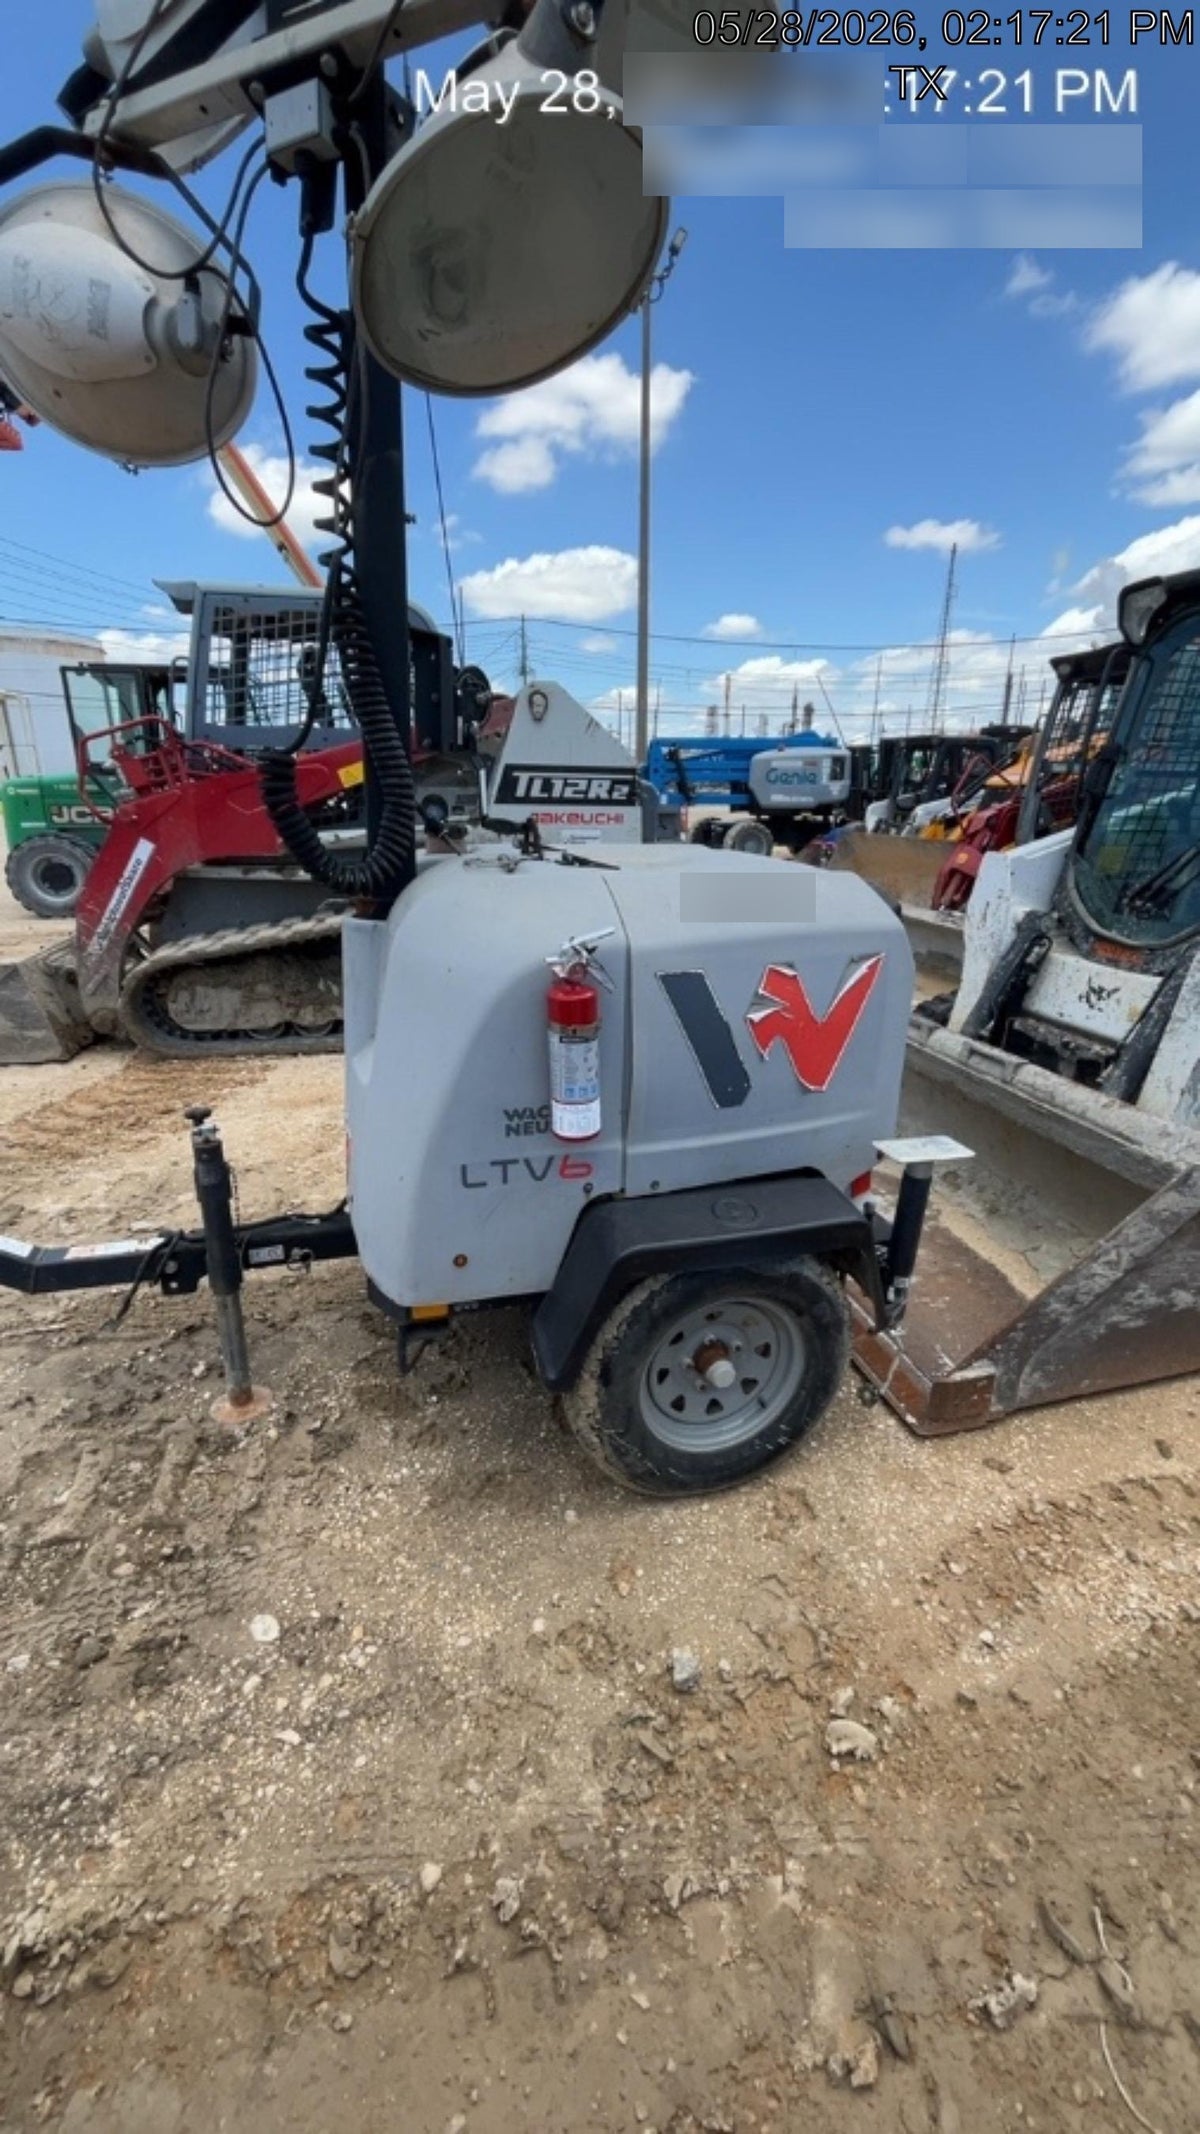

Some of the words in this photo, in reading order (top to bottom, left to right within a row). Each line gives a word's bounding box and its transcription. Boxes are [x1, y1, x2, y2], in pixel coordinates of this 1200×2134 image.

[765, 768, 818, 785] Genie
[512, 772, 634, 800] TL12R2
[503, 1105, 551, 1122] WAC
[504, 1121, 551, 1138] NEU
[461, 1154, 594, 1189] LTV6
